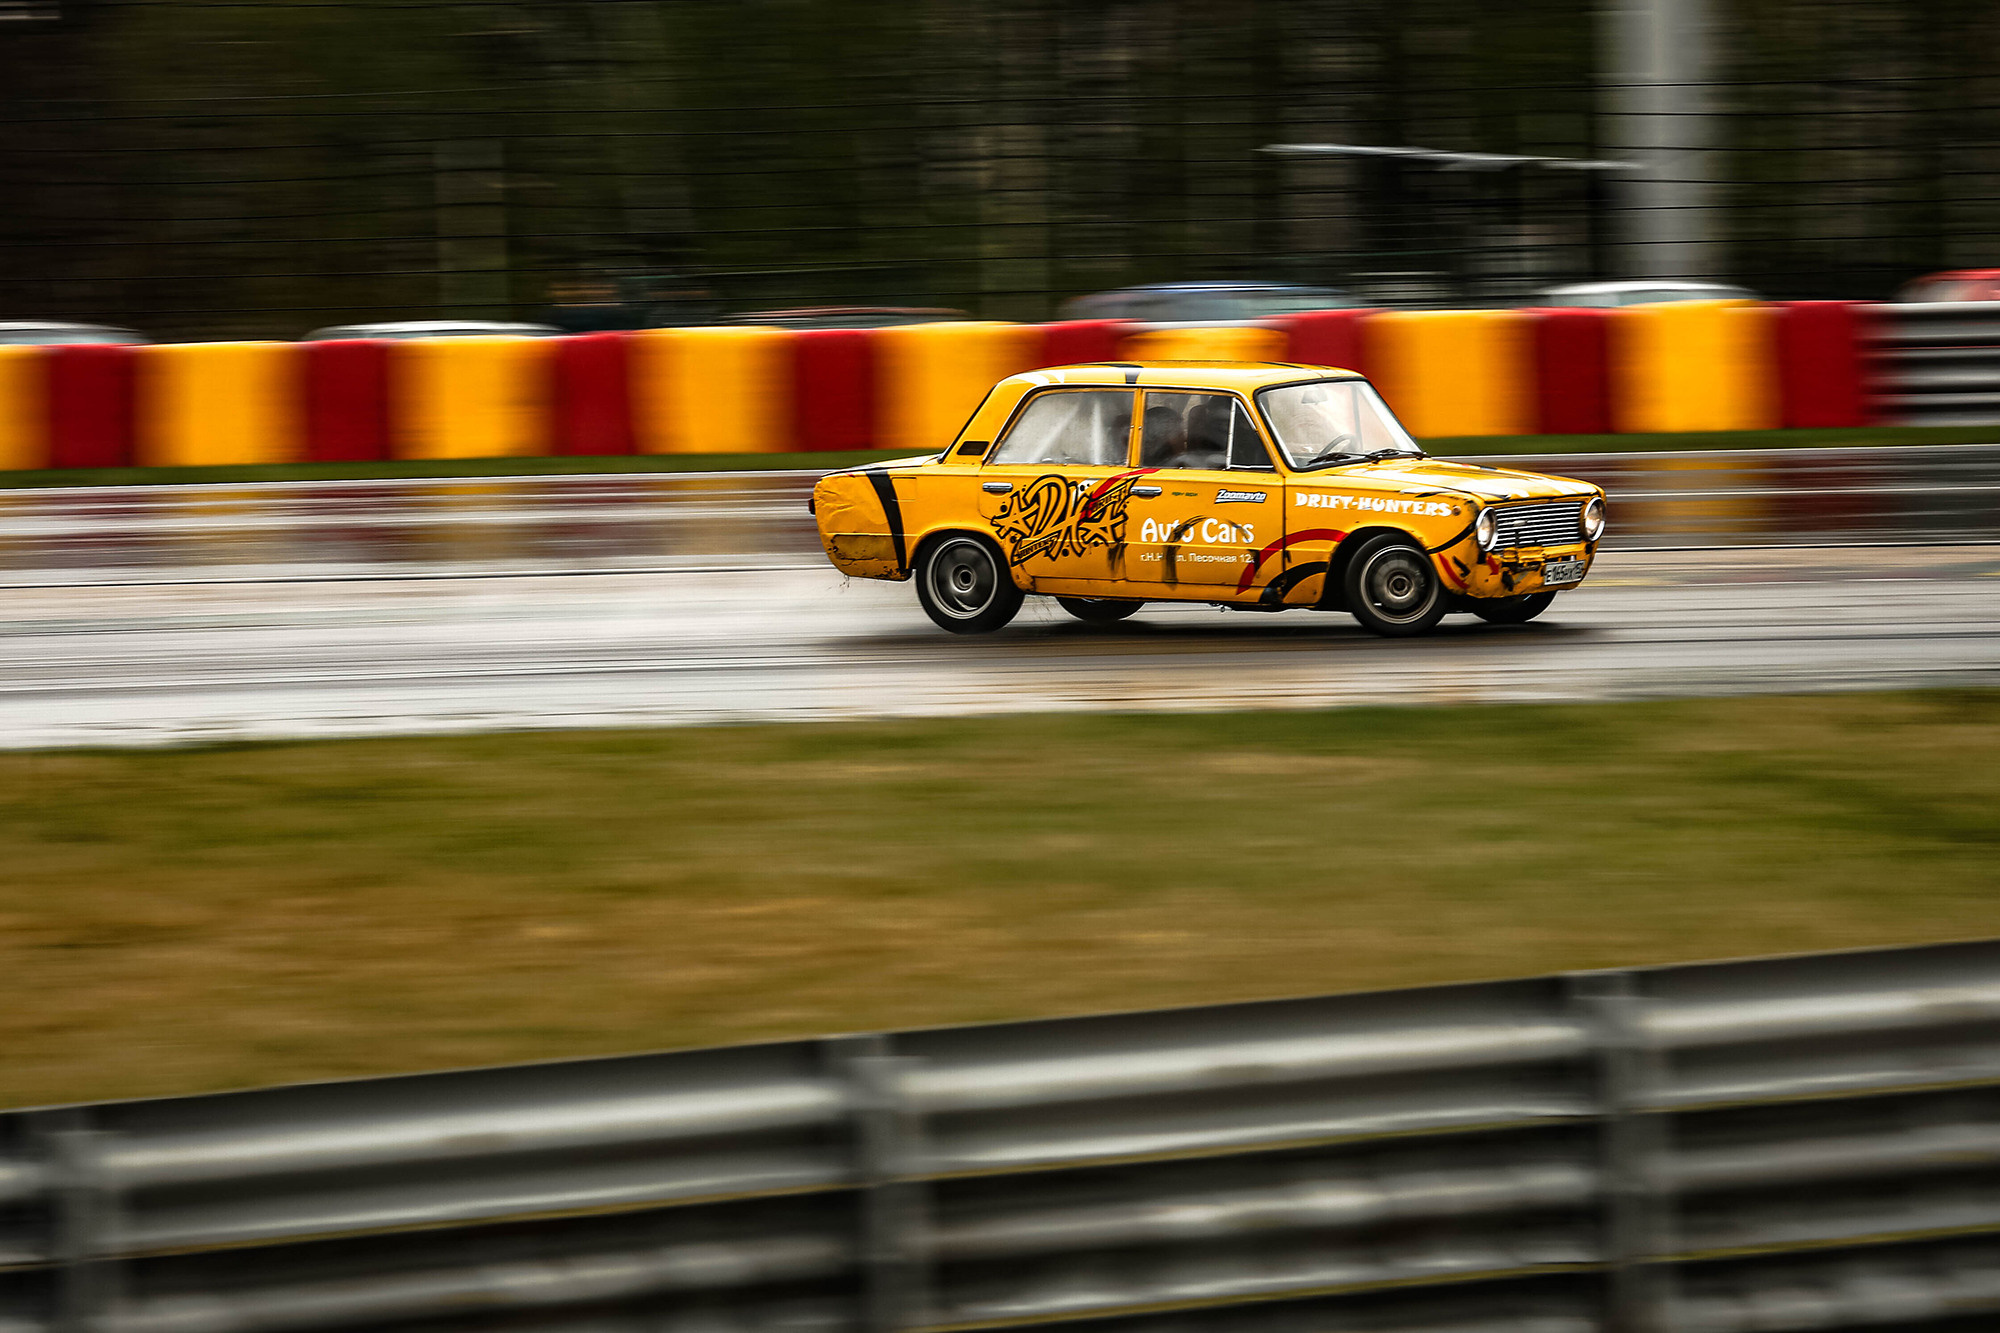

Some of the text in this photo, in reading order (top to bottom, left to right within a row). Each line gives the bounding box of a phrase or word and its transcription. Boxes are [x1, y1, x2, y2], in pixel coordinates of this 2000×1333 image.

[1295, 492, 1453, 517] DRIFT-HUNTERS
[1201, 518, 1255, 543] Cars
[1189, 552, 1237, 563] Песочная
